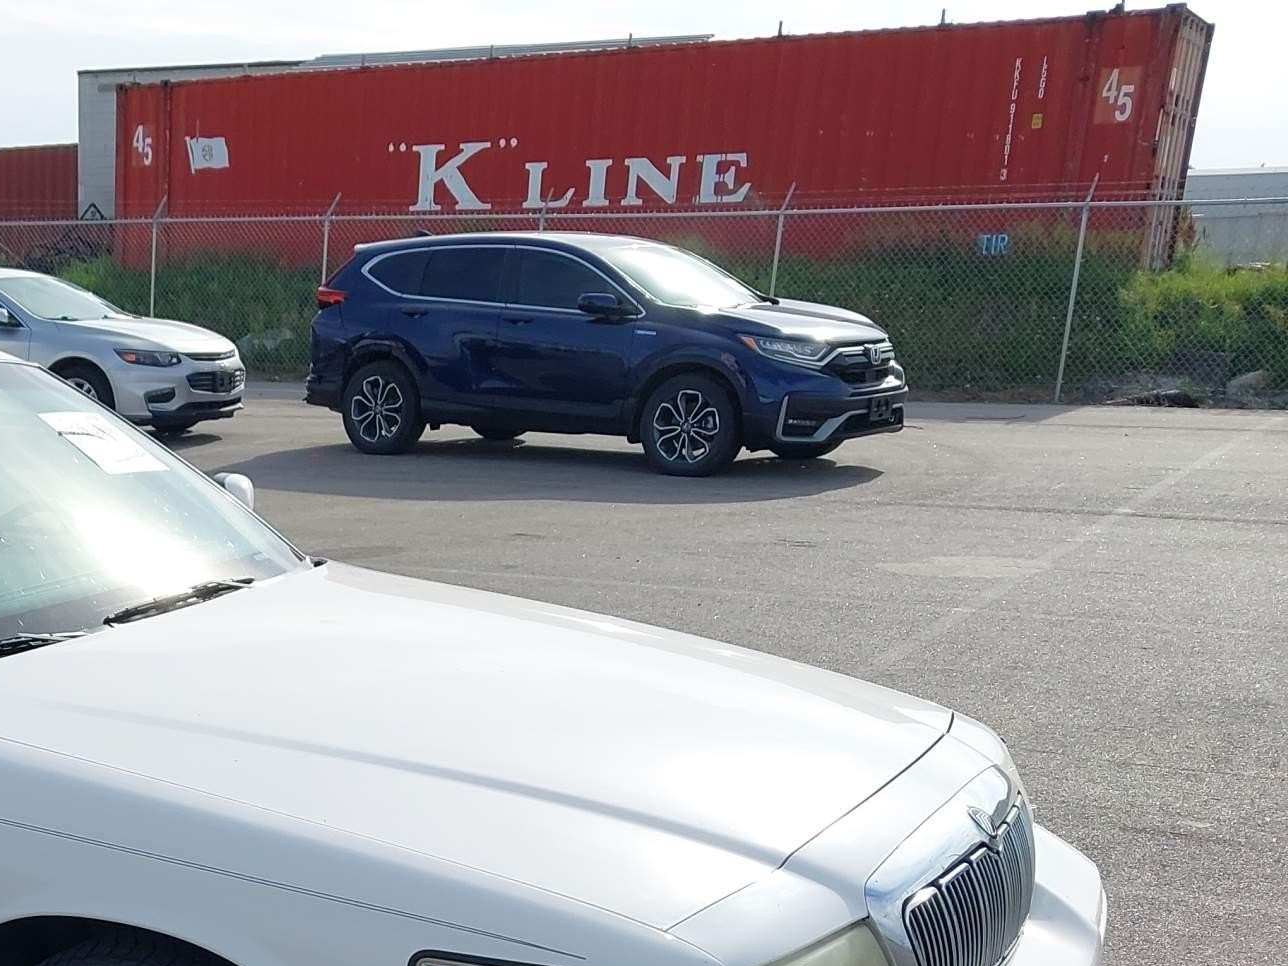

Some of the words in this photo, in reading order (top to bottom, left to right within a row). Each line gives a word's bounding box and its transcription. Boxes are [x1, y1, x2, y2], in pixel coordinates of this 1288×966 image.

[1102, 68, 1135, 122] 45
[133, 124, 152, 166] 45
[522, 152, 753, 210] LINE
[982, 234, 1009, 256] TIR
